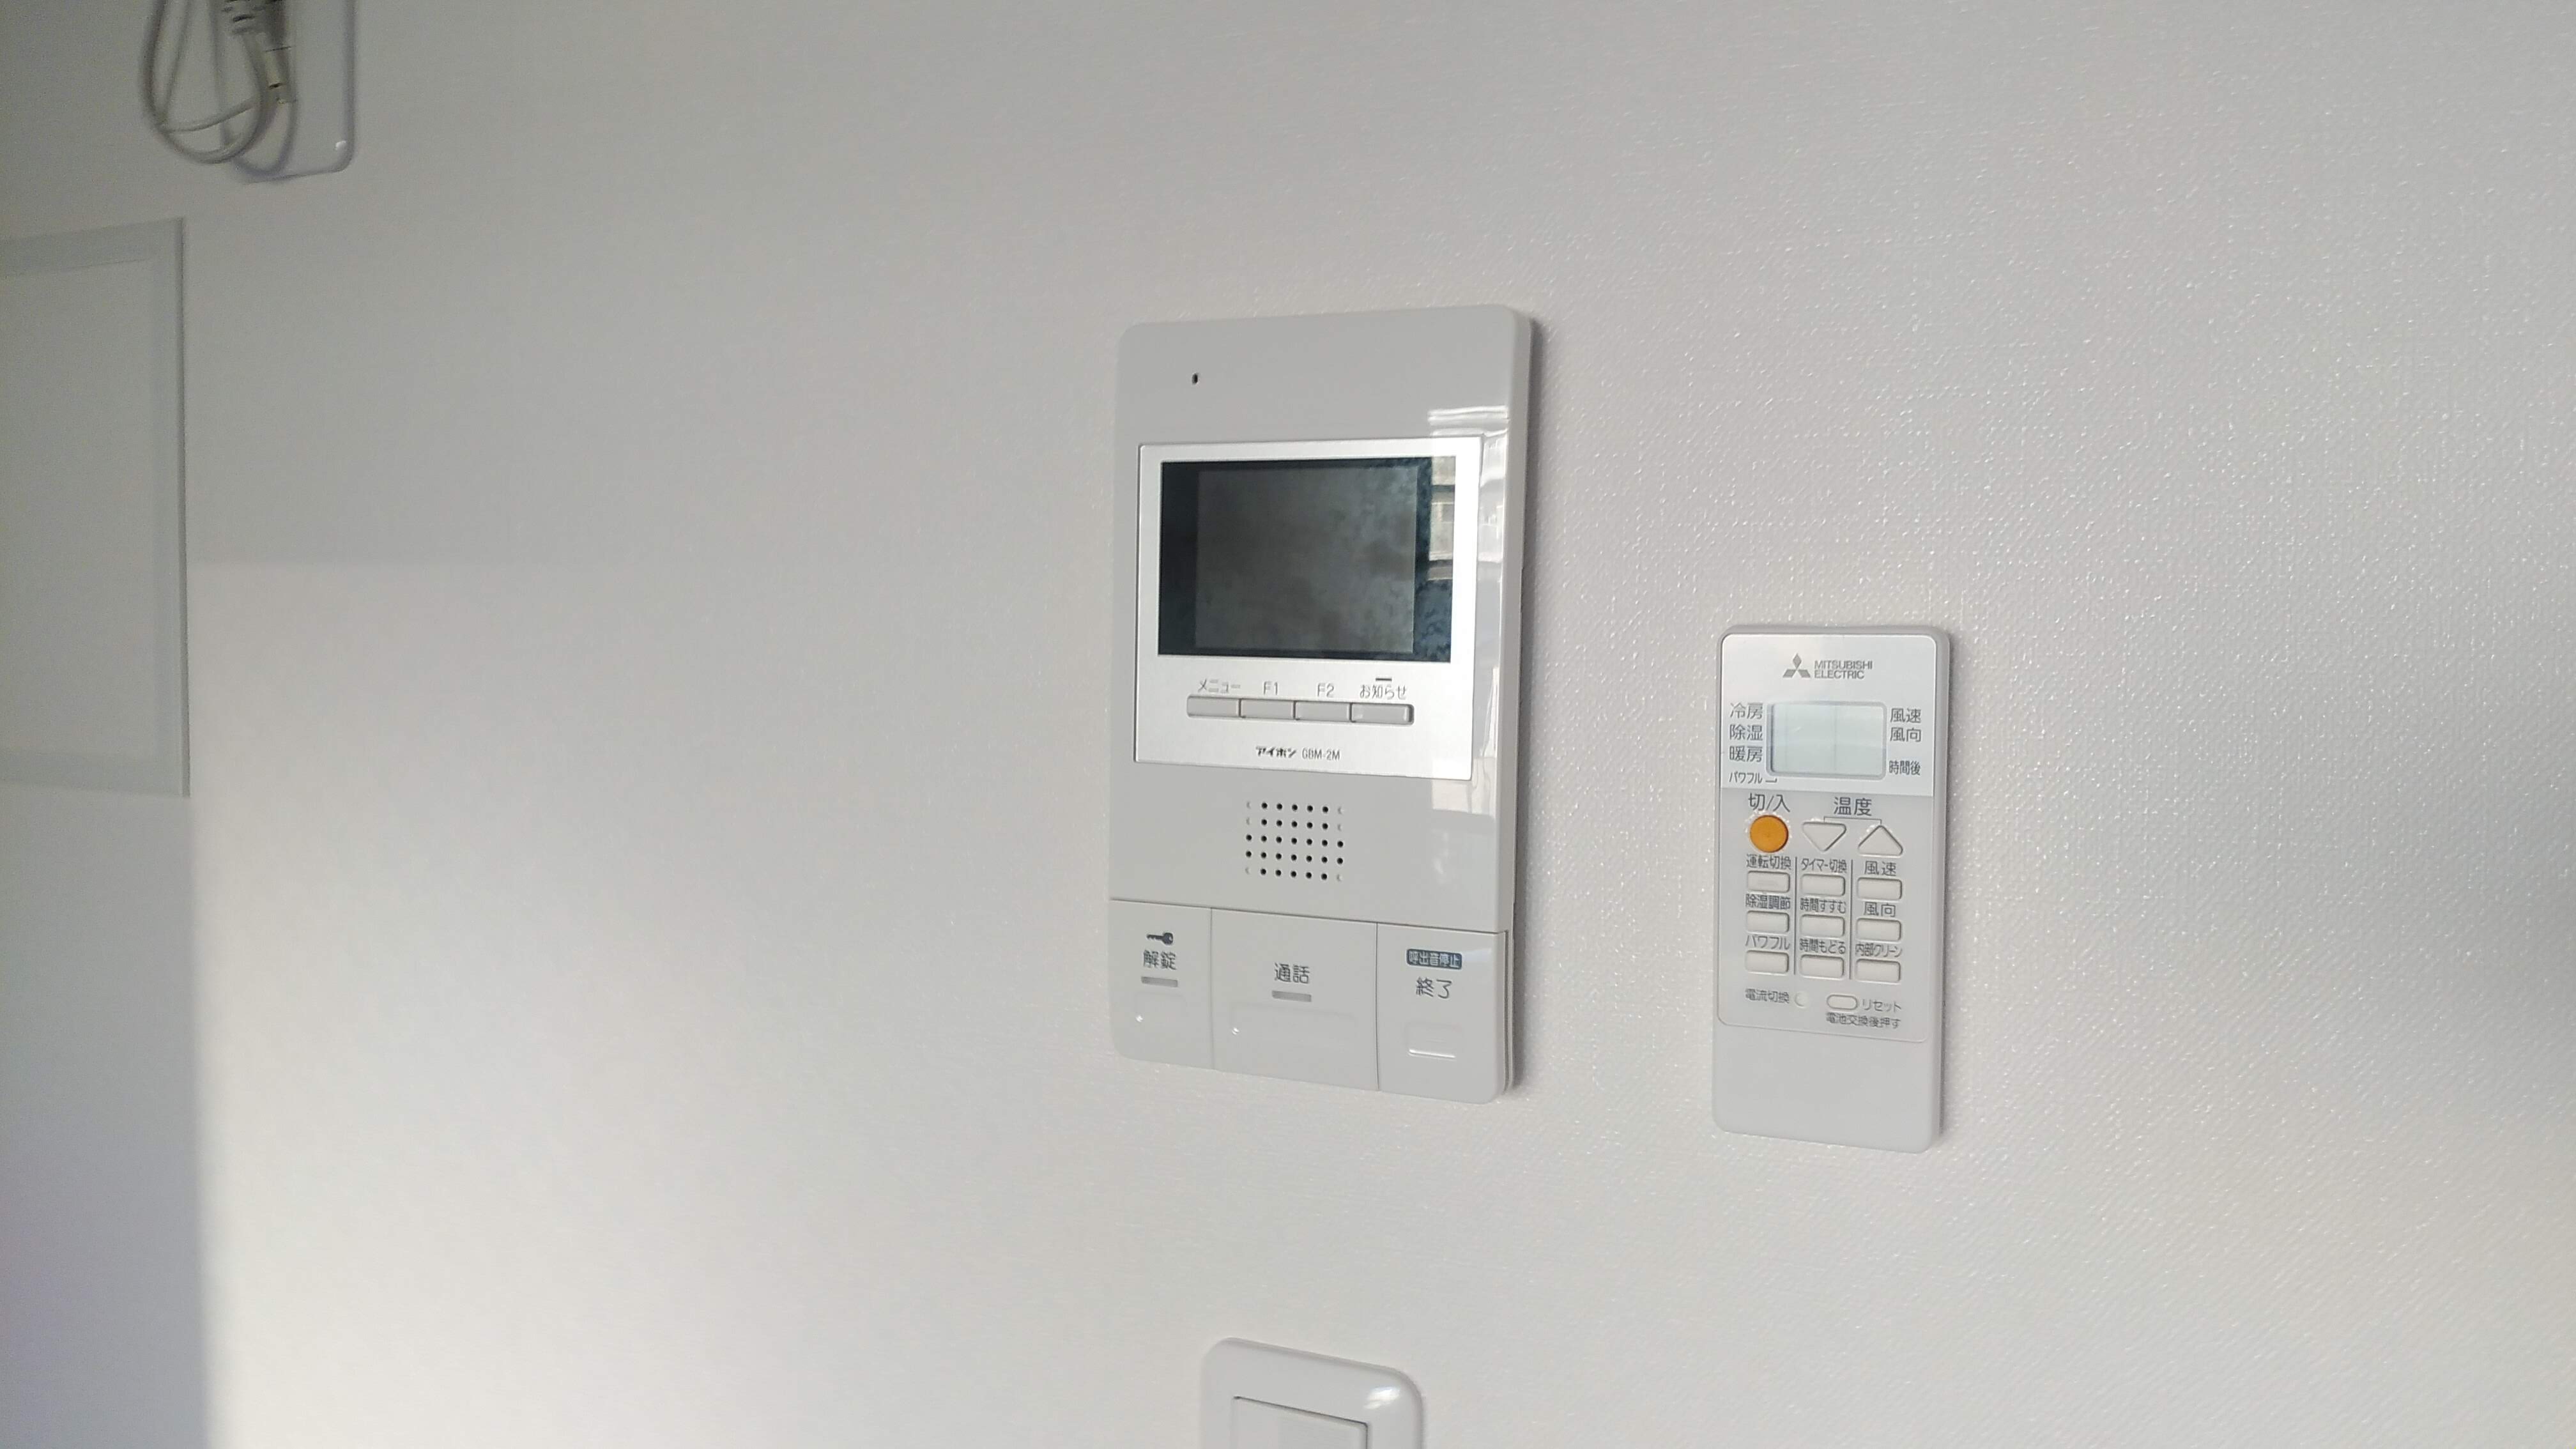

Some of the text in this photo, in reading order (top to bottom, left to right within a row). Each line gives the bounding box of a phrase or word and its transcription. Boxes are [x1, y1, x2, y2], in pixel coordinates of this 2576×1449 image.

[1814, 660, 1873, 670] MITSUBISHI
[1814, 670, 1865, 680] ELECTRIC
[1263, 681, 1278, 695] F1
[1317, 683, 1335, 697] F2
[1359, 684, 1407, 700] お知らせ
[1730, 703, 1763, 719] 冷房
[1890, 708, 1921, 723] 風速
[1729, 724, 1763, 741] 除湿
[1890, 727, 1921, 742] 風向
[1256, 746, 1296, 758] アイホン
[1729, 745, 1763, 762] 暖房
[1889, 760, 1920, 776] 時間後
[1729, 772, 1762, 785] パワフル
[1748, 793, 1790, 812] 切/入
[1833, 797, 1872, 816] 温度
[1746, 854, 1791, 870] 運転切換
[1801, 858, 1847, 873] タイマー切換
[1864, 861, 1897, 876] 風速
[1745, 894, 1791, 910] 除湿調節
[1800, 898, 1846, 914] 時間すすむ
[1864, 902, 1896, 917] 風向
[1745, 935, 1790, 950] パワフル
[1799, 939, 1846, 954] 時間もどる
[1855, 942, 1903, 958] 内部クリーン
[1274, 962, 1310, 984] 通話
[1416, 976, 1452, 999] 終了
[1862, 999, 1901, 1012] リセット
[1826, 1011, 1901, 1029] 電池交換後押す
